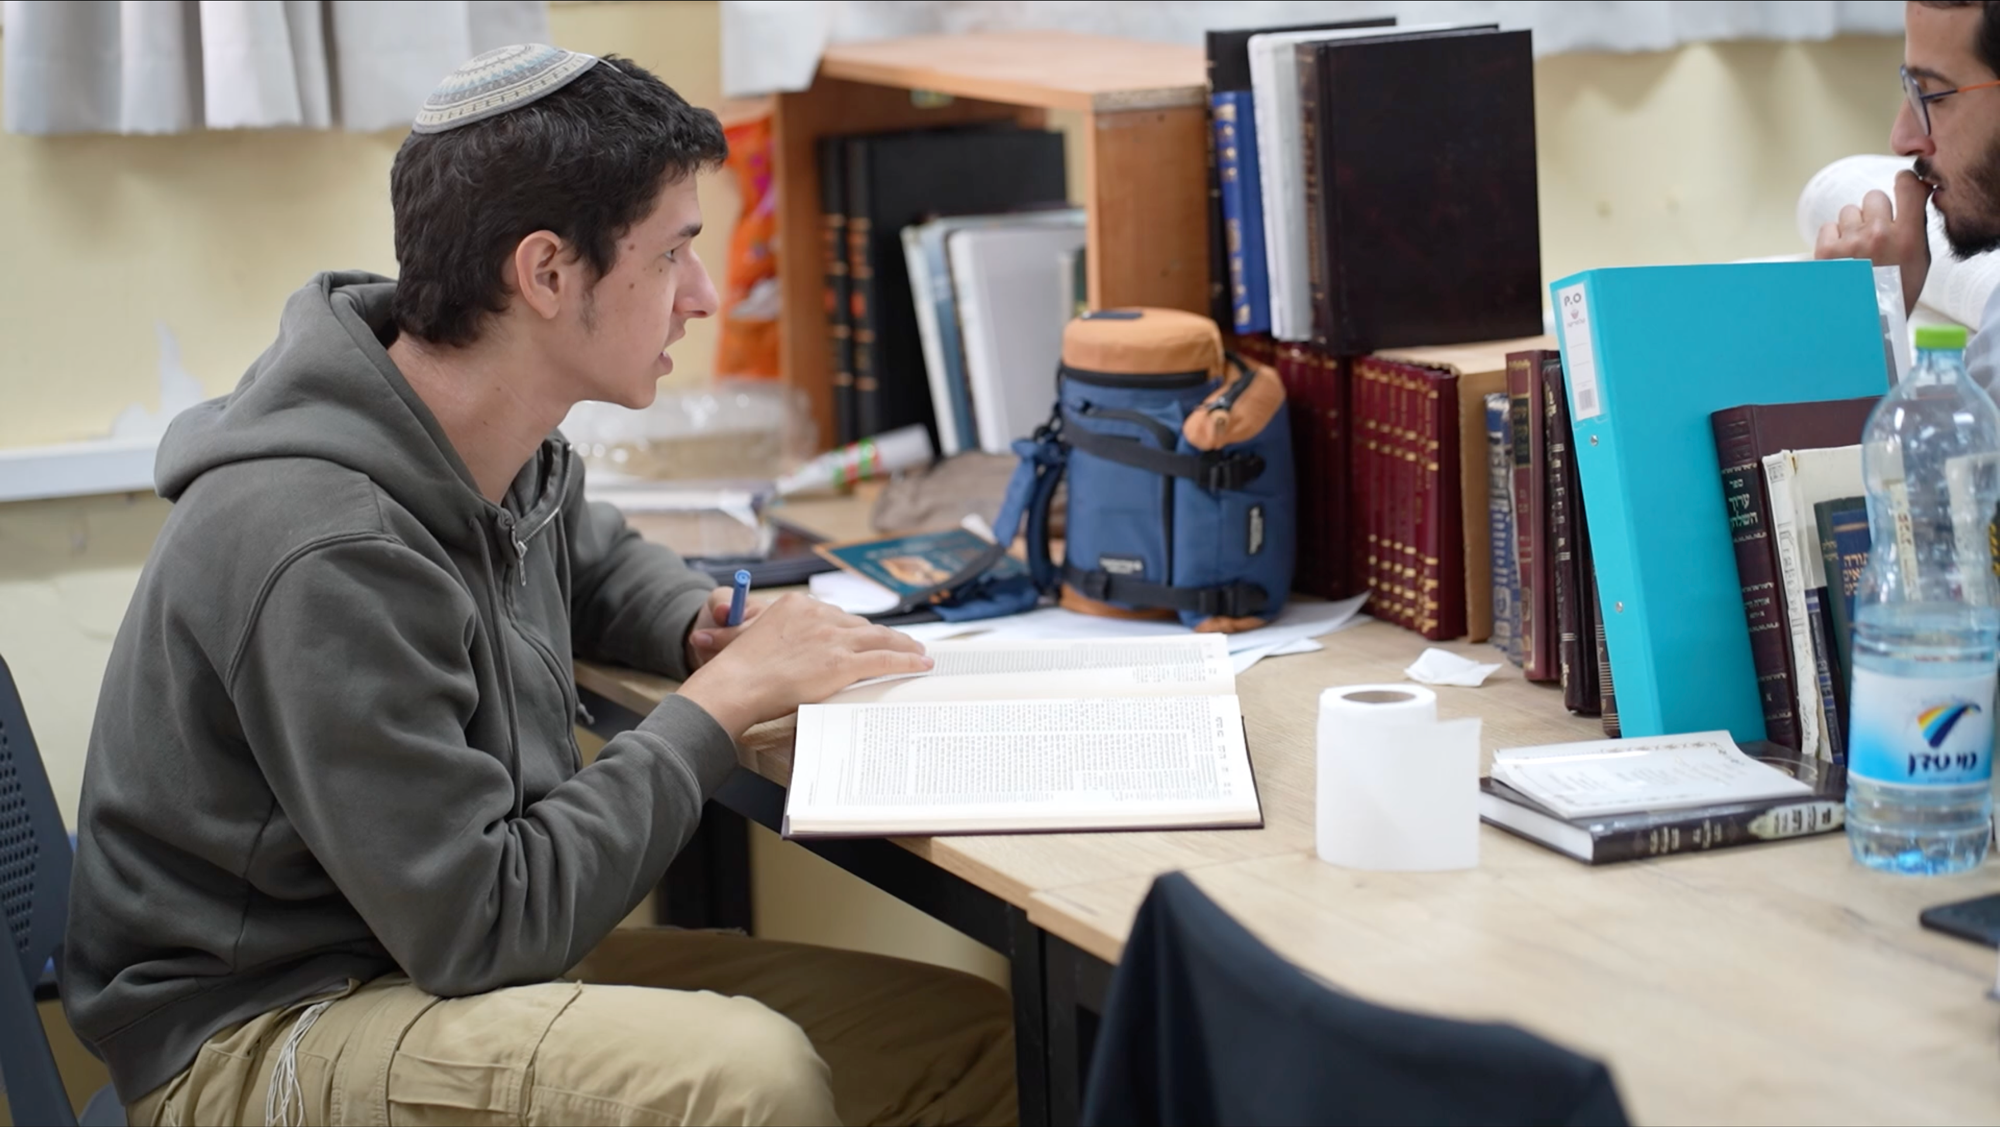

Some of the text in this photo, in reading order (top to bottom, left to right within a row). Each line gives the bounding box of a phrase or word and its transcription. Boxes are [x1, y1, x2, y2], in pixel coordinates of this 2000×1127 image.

[1563, 292, 1582, 307] P.O
[1729, 478, 1744, 489] ספר
[1728, 493, 1751, 511] ערוך
[1908, 751, 1978, 778] מי עדן
